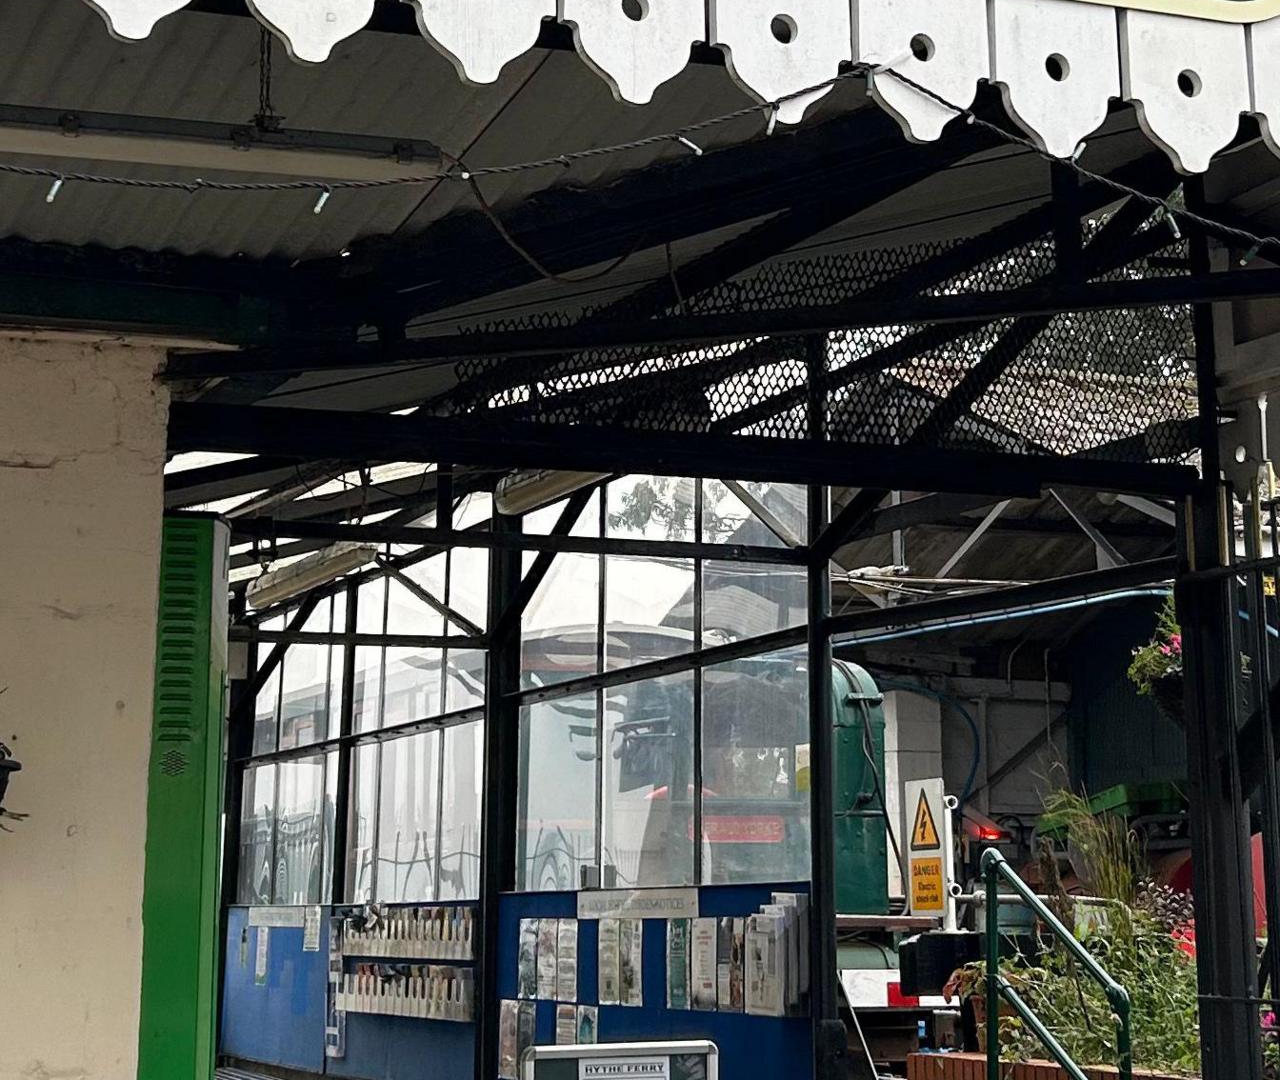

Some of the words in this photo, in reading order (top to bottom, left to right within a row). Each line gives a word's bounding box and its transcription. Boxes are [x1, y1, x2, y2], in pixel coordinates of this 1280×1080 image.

[913, 864, 940, 877] DANGER
[584, 1063, 622, 1074] HYTHE
[626, 1062, 665, 1073] FERRY
